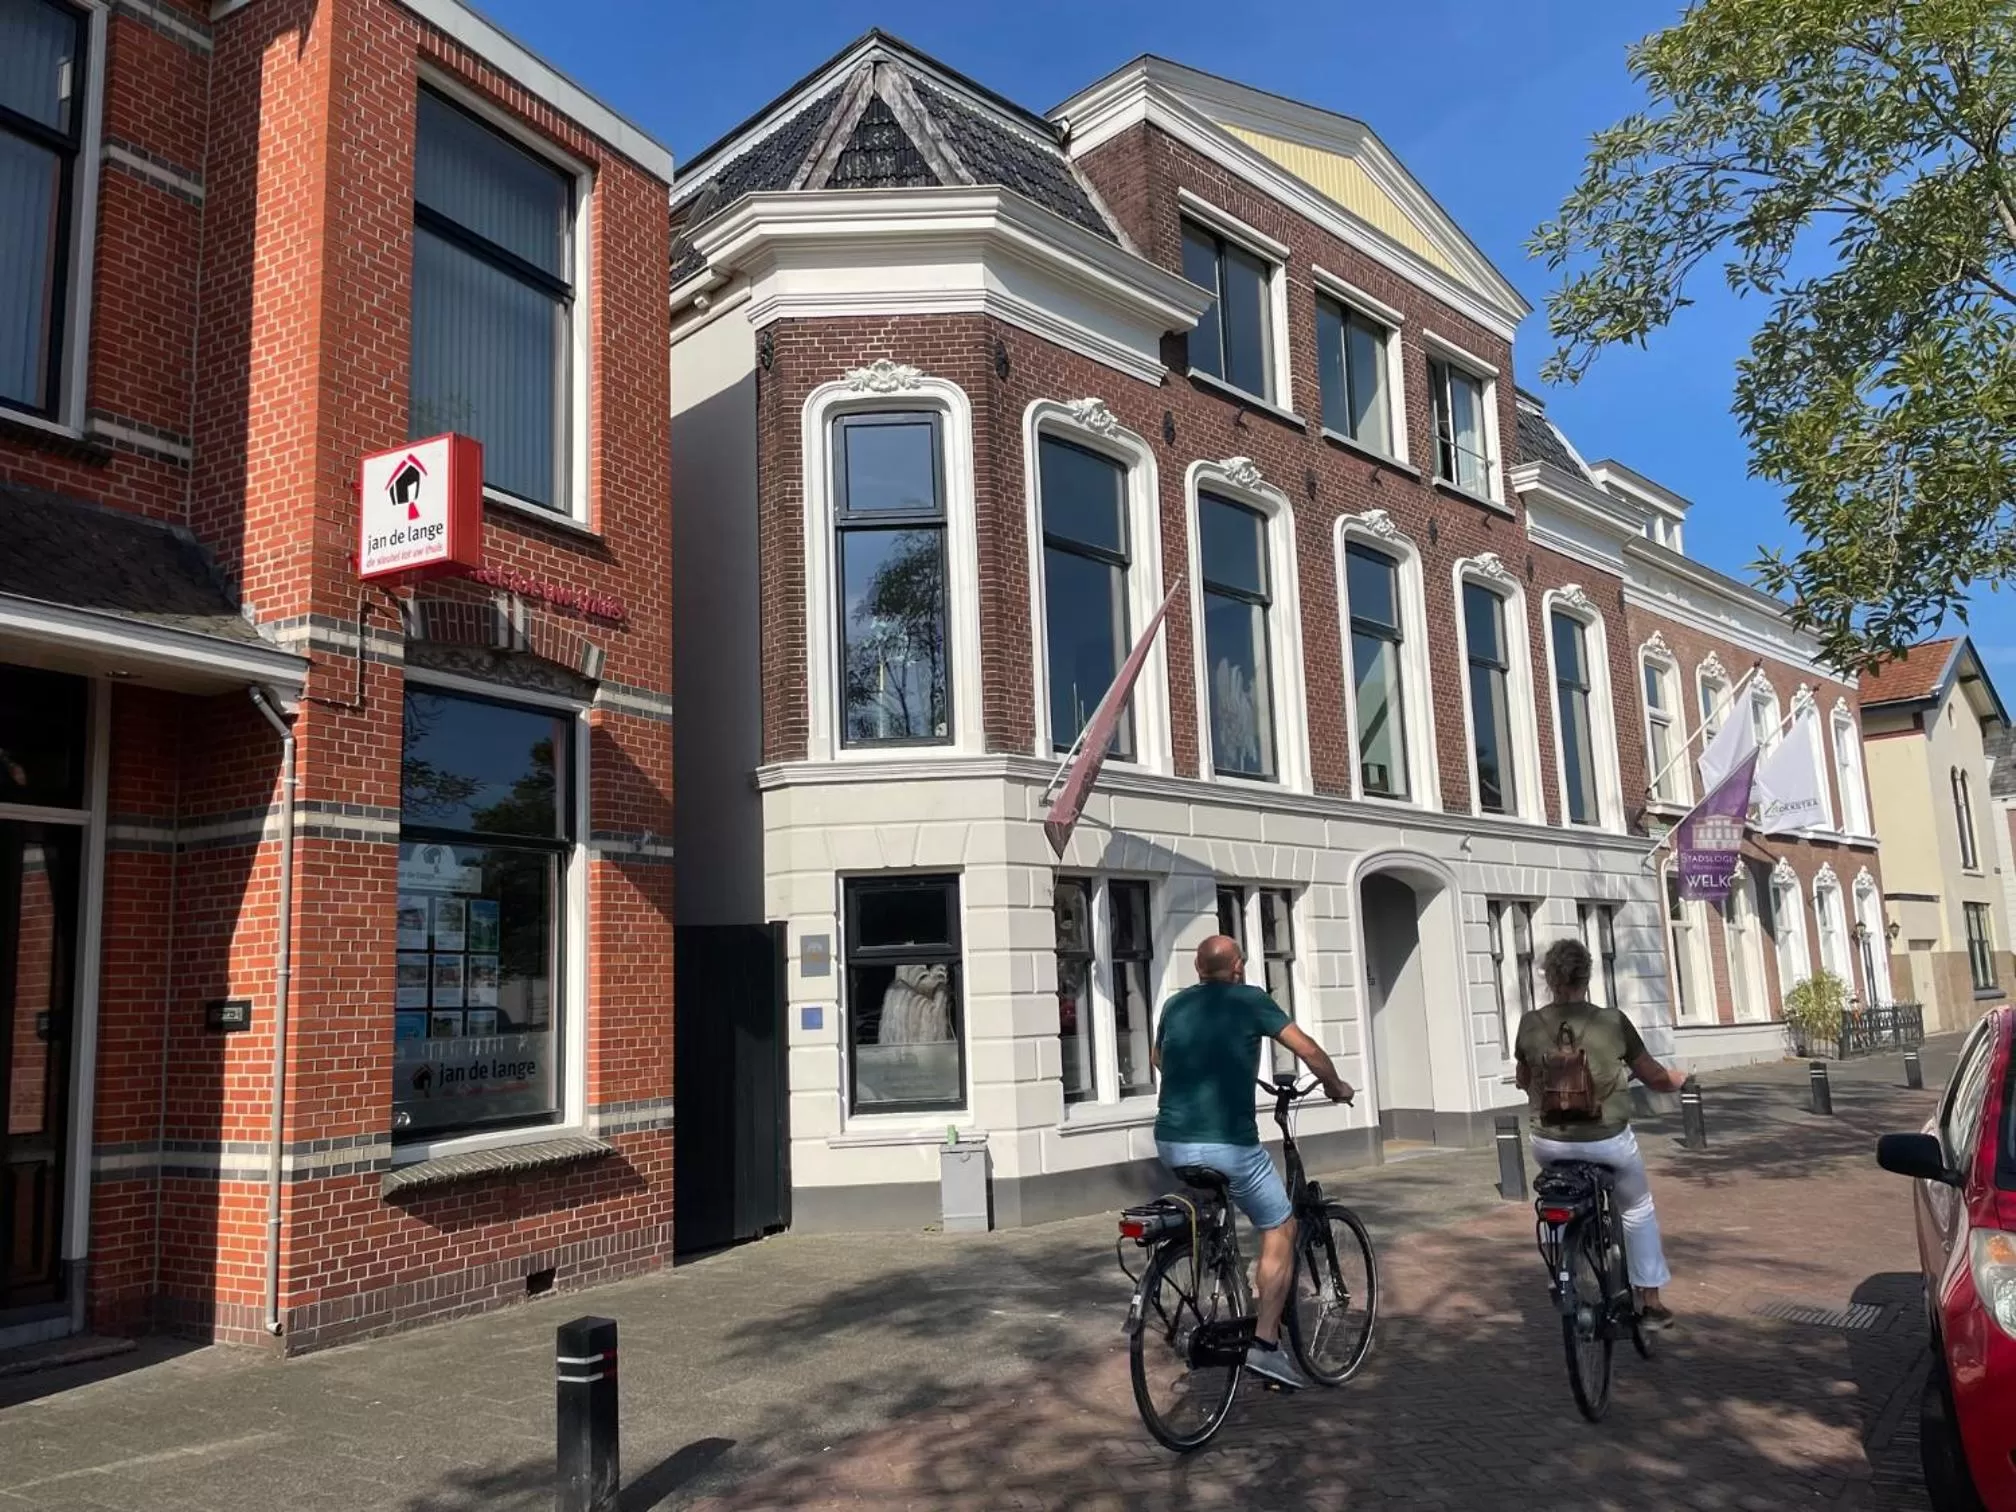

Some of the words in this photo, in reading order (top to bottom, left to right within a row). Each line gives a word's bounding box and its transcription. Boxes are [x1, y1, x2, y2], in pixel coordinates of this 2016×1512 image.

[368, 535, 387, 556] jan
[389, 528, 405, 545] de
[408, 522, 443, 541] lange
[440, 1063, 465, 1087] jan
[469, 1060, 489, 1080] de
[492, 1059, 536, 1081] lange
